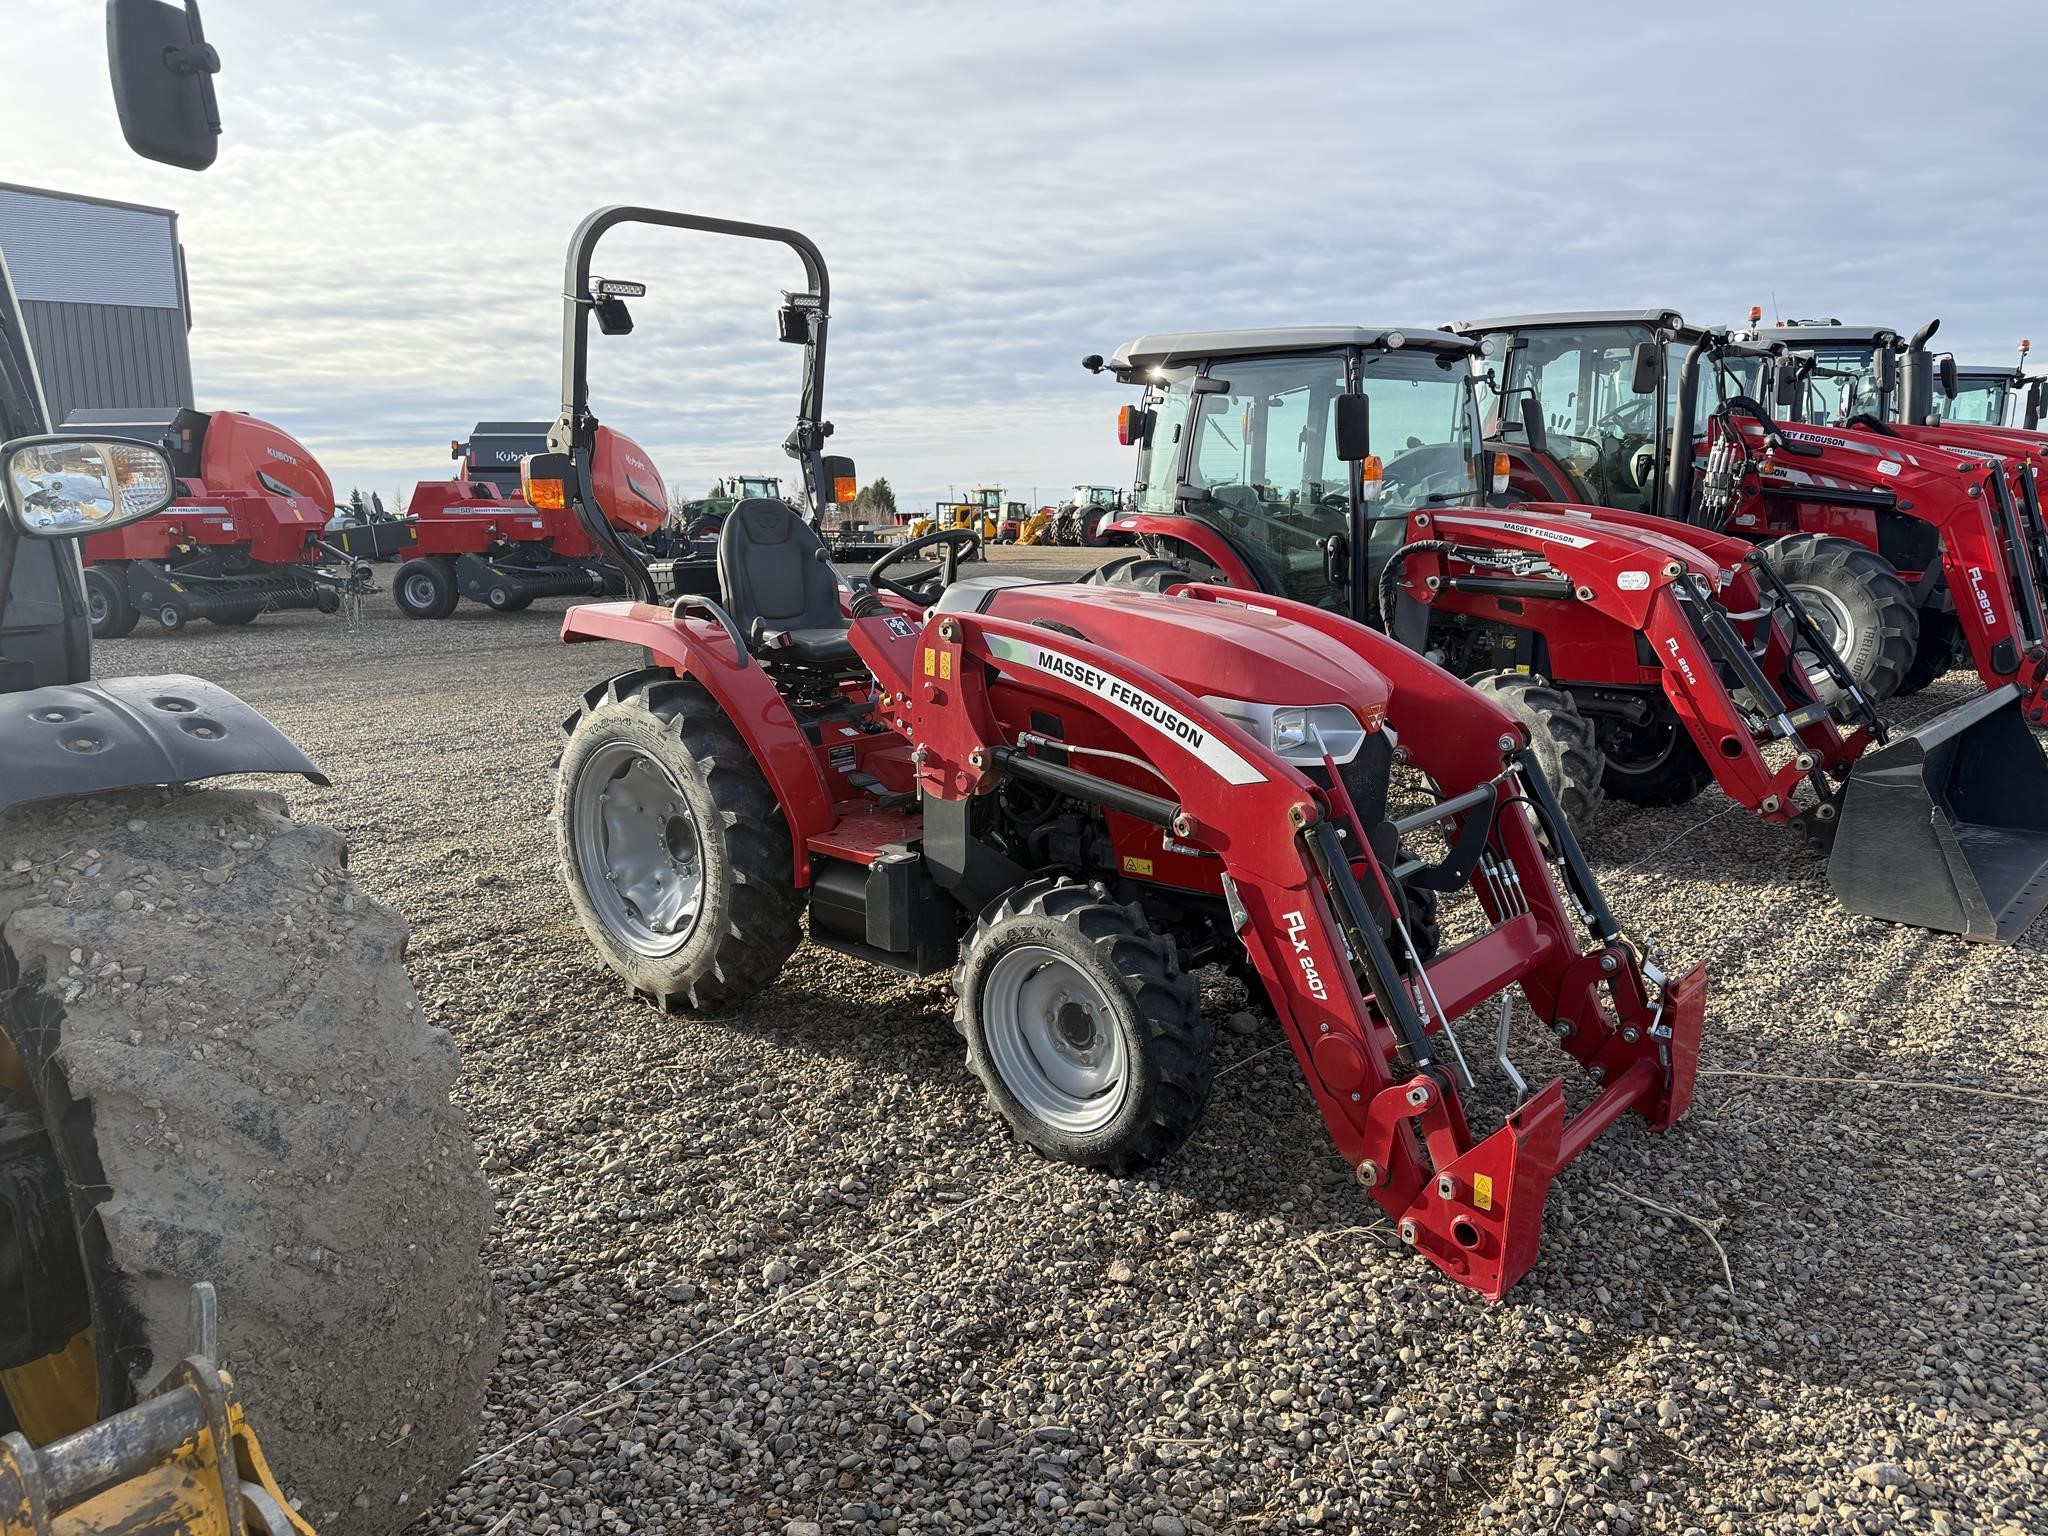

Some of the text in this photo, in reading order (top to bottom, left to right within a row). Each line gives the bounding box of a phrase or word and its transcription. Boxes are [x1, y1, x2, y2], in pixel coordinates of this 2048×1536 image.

[266, 447, 298, 466] KUBOTA
[1799, 432, 1845, 447] FERGUSON
[1967, 450, 1994, 459] FERGUSON
[1503, 522, 1575, 544] MASSEY FERGUSON
[1665, 637, 1697, 685] FL 2814
[1851, 625, 1878, 681] TRELLEBOR
[1038, 651, 1204, 749] MASSEY FERGUSON
[975, 926, 1053, 970] GALAXY
[1282, 910, 1328, 1000] FLX 2407
